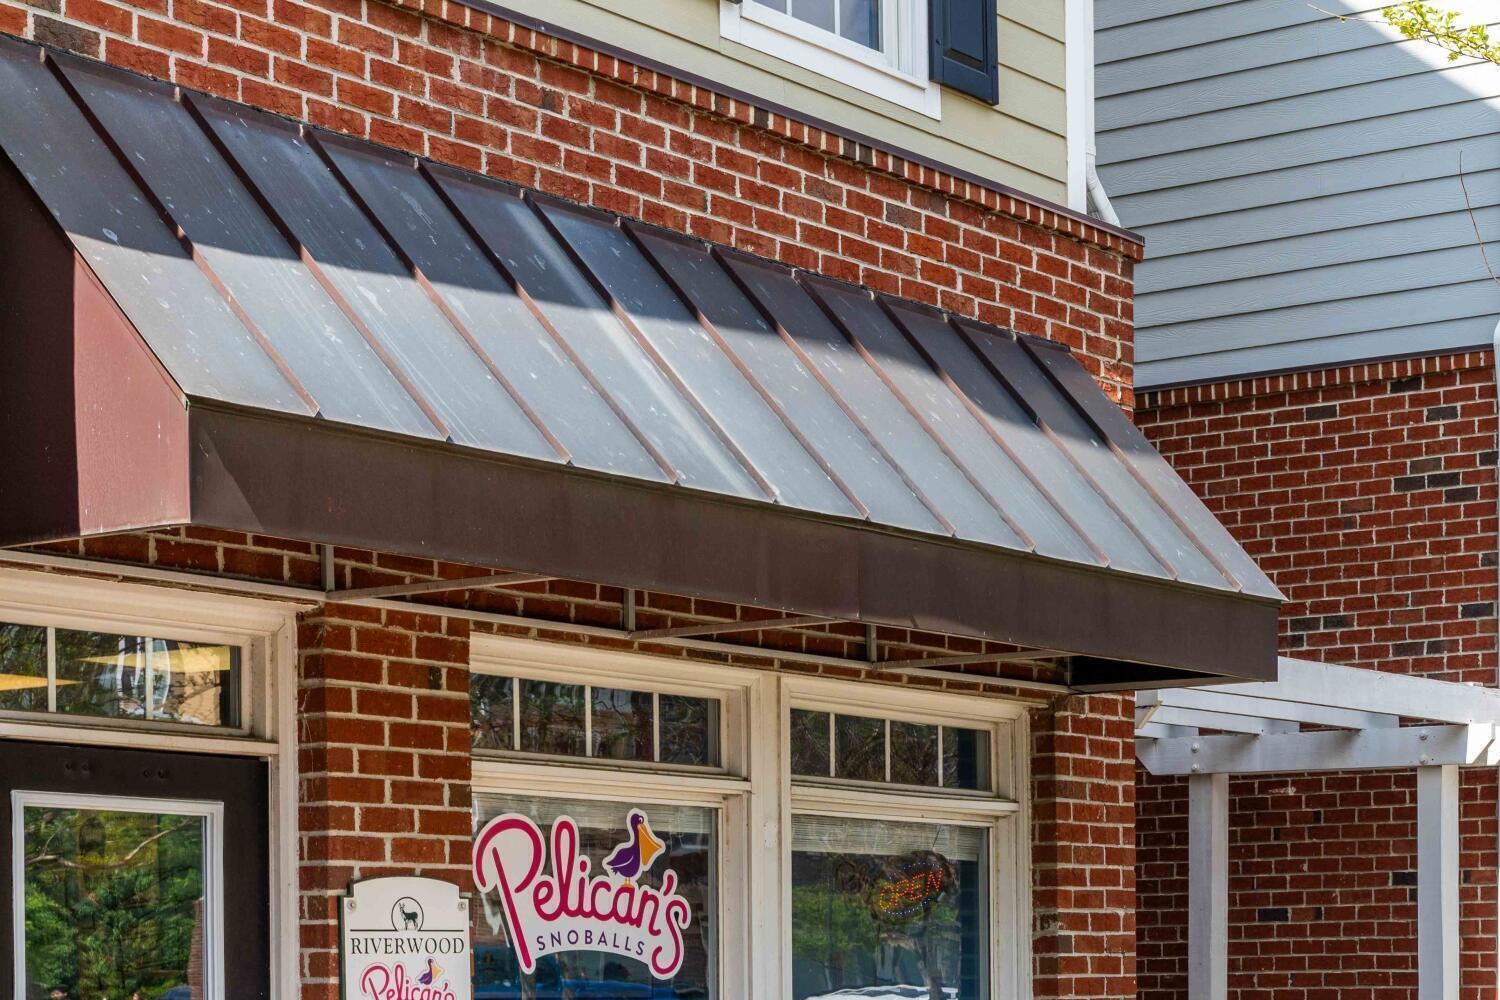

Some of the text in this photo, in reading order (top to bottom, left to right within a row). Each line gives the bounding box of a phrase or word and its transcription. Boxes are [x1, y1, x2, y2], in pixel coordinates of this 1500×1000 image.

[475, 818, 688, 974] Pelican's
[879, 867, 944, 910] OPEN
[351, 937, 465, 955] RIVERWOOD
[536, 928, 646, 956] SNOBALLS
